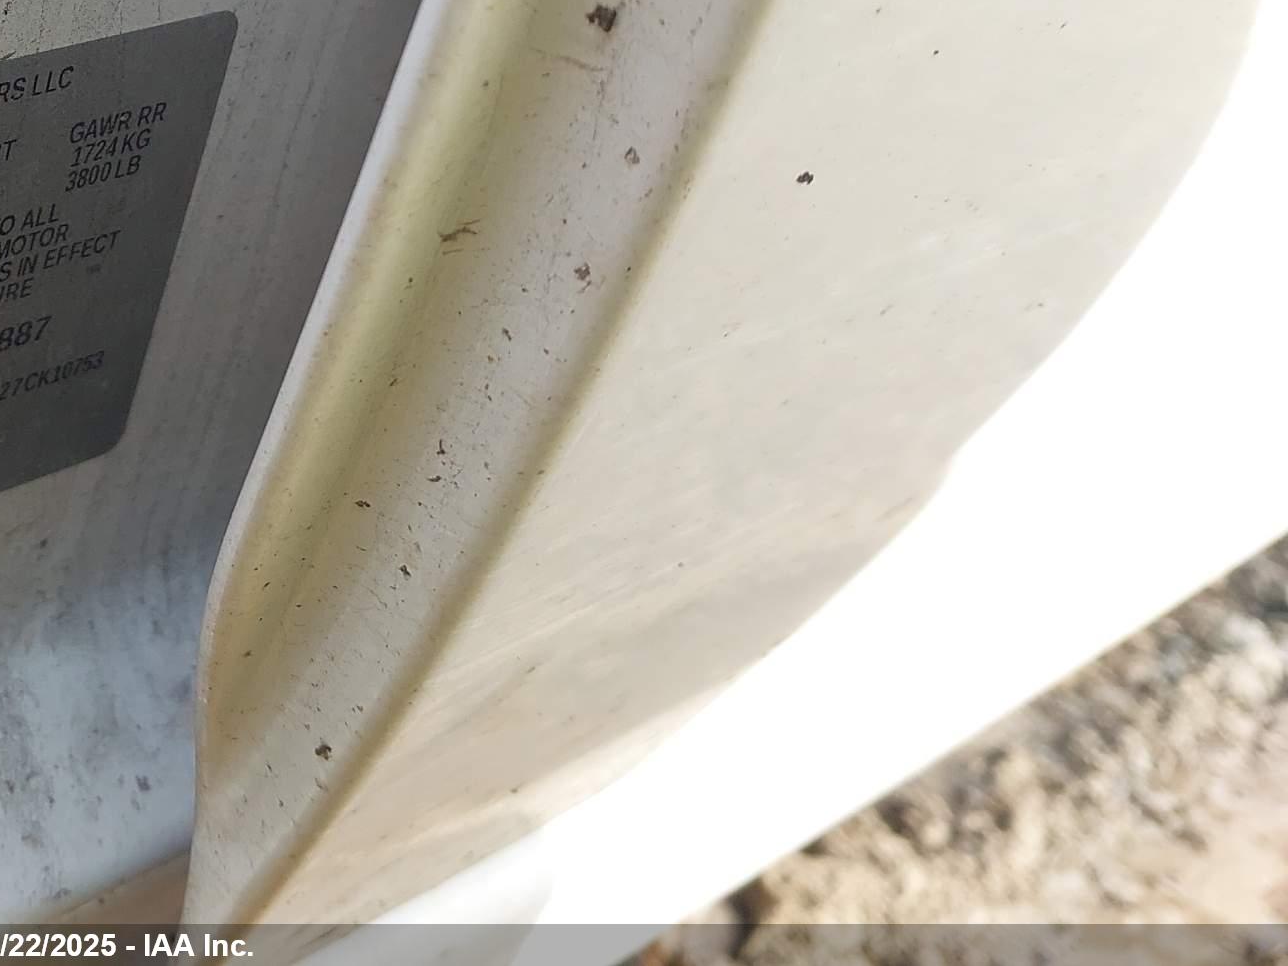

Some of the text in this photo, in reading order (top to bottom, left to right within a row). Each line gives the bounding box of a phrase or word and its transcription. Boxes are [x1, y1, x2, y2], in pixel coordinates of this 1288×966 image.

[31, 66, 73, 96] LLC
[69, 114, 132, 144] GAWR
[136, 101, 167, 125] RR
[70, 141, 118, 168] 1724
[121, 130, 151, 156] KG
[65, 164, 112, 192] 3800
[114, 155, 141, 177] LB
[21, 204, 60, 231] ALL
[17, 253, 39, 278] IN
[43, 230, 122, 269] EFFECT
